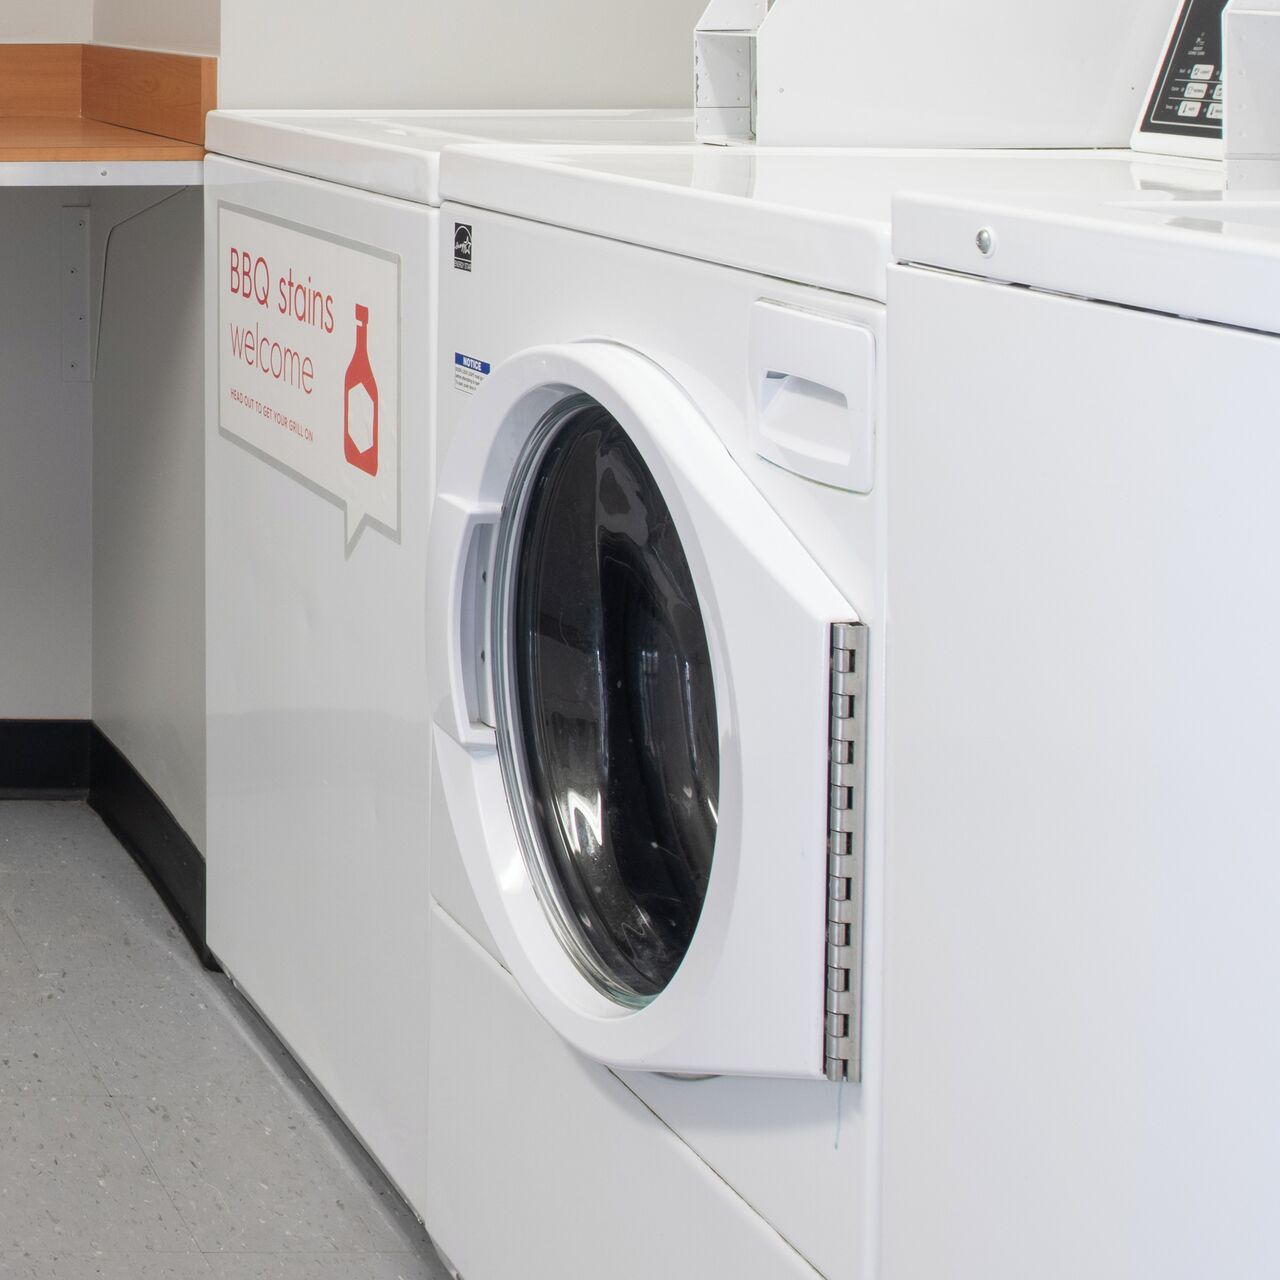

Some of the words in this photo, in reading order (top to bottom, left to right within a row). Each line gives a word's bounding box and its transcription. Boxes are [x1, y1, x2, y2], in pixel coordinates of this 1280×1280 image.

[230, 247, 270, 309] BBQ
[278, 267, 334, 334] stains
[230, 321, 314, 394] welcome
[463, 356, 482, 371] NOTICE
[230, 387, 244, 404] HEAD
[244, 395, 254, 409] OUT
[255, 401, 262, 414] TO
[262, 405, 272, 420] GET
[273, 411, 288, 428] YOUR
[288, 419, 304, 438] GRILL
[304, 427, 314, 441] ON
